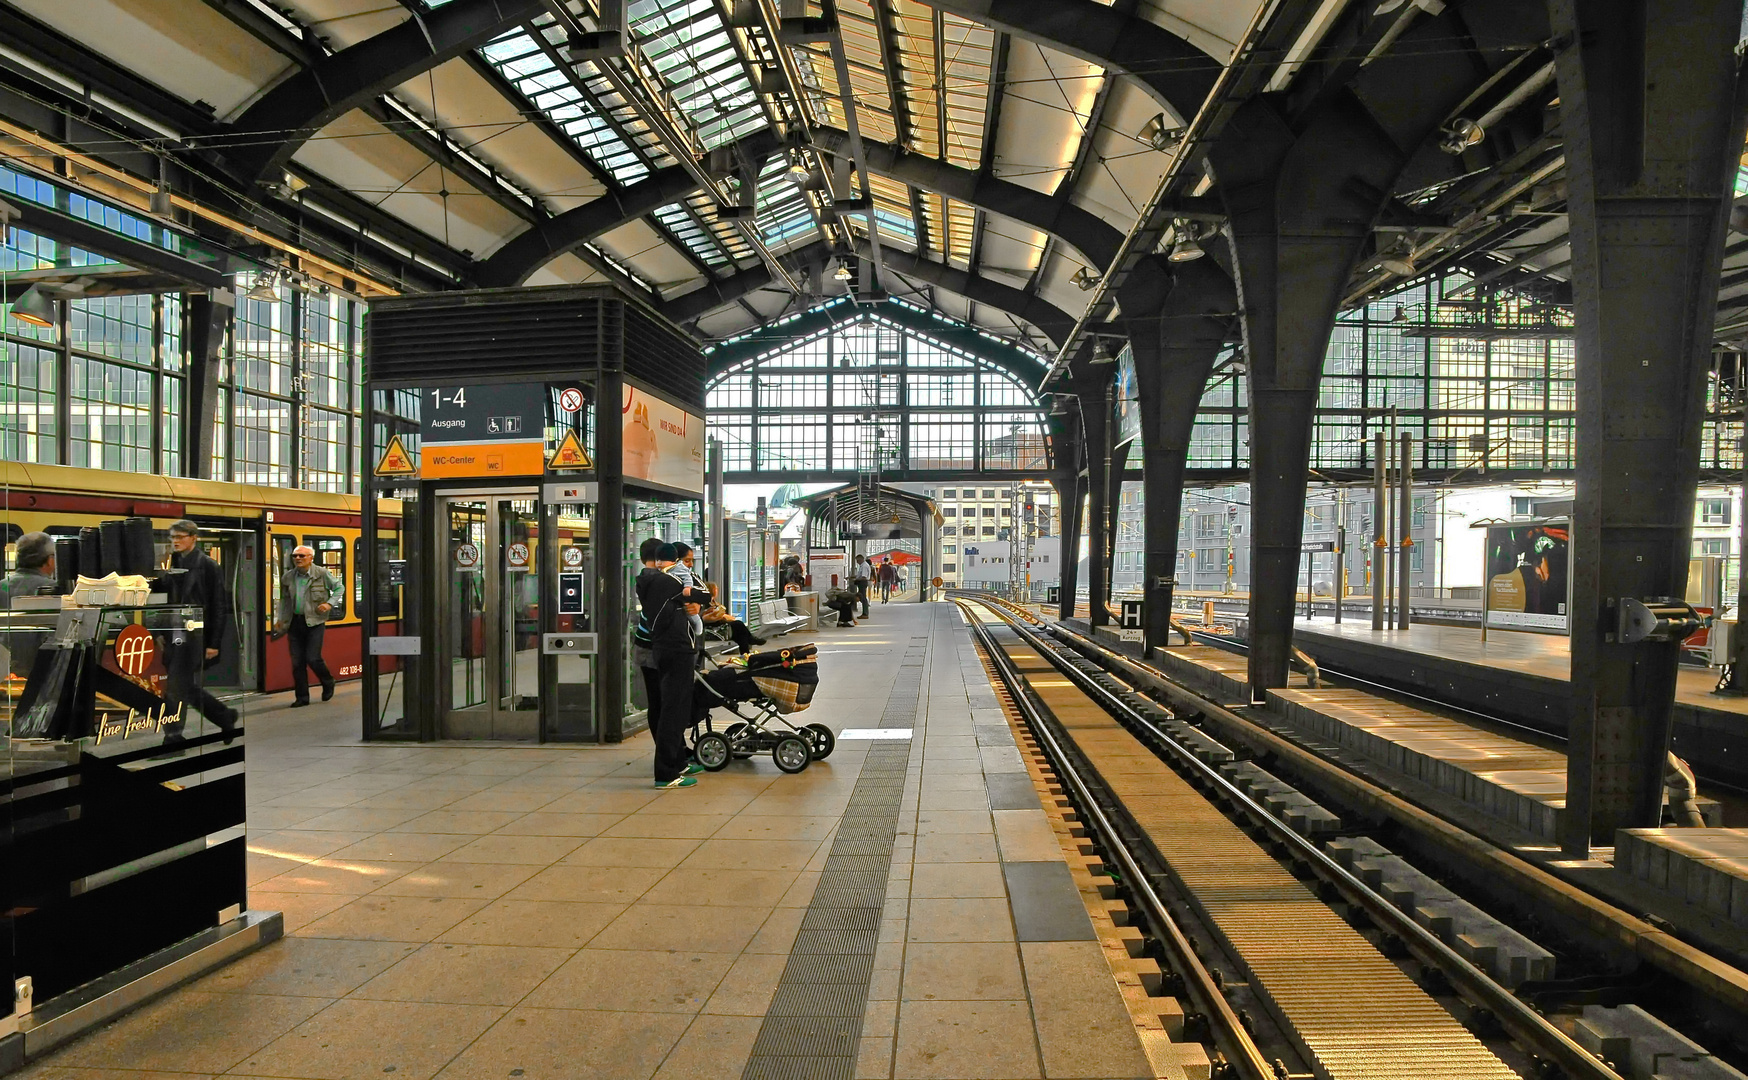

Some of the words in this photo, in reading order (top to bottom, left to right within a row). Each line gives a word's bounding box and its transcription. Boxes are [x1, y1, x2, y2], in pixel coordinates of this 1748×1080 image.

[431, 387, 466, 409] 1-4
[431, 419, 466, 428] Ausgang
[432, 456, 475, 464] WC-Center
[1049, 588, 1059, 602] H
[1123, 604, 1141, 626] H
[117, 635, 153, 675] fff
[95, 712, 121, 746] fine
[122, 706, 153, 740] fresh
[155, 700, 183, 734] food
